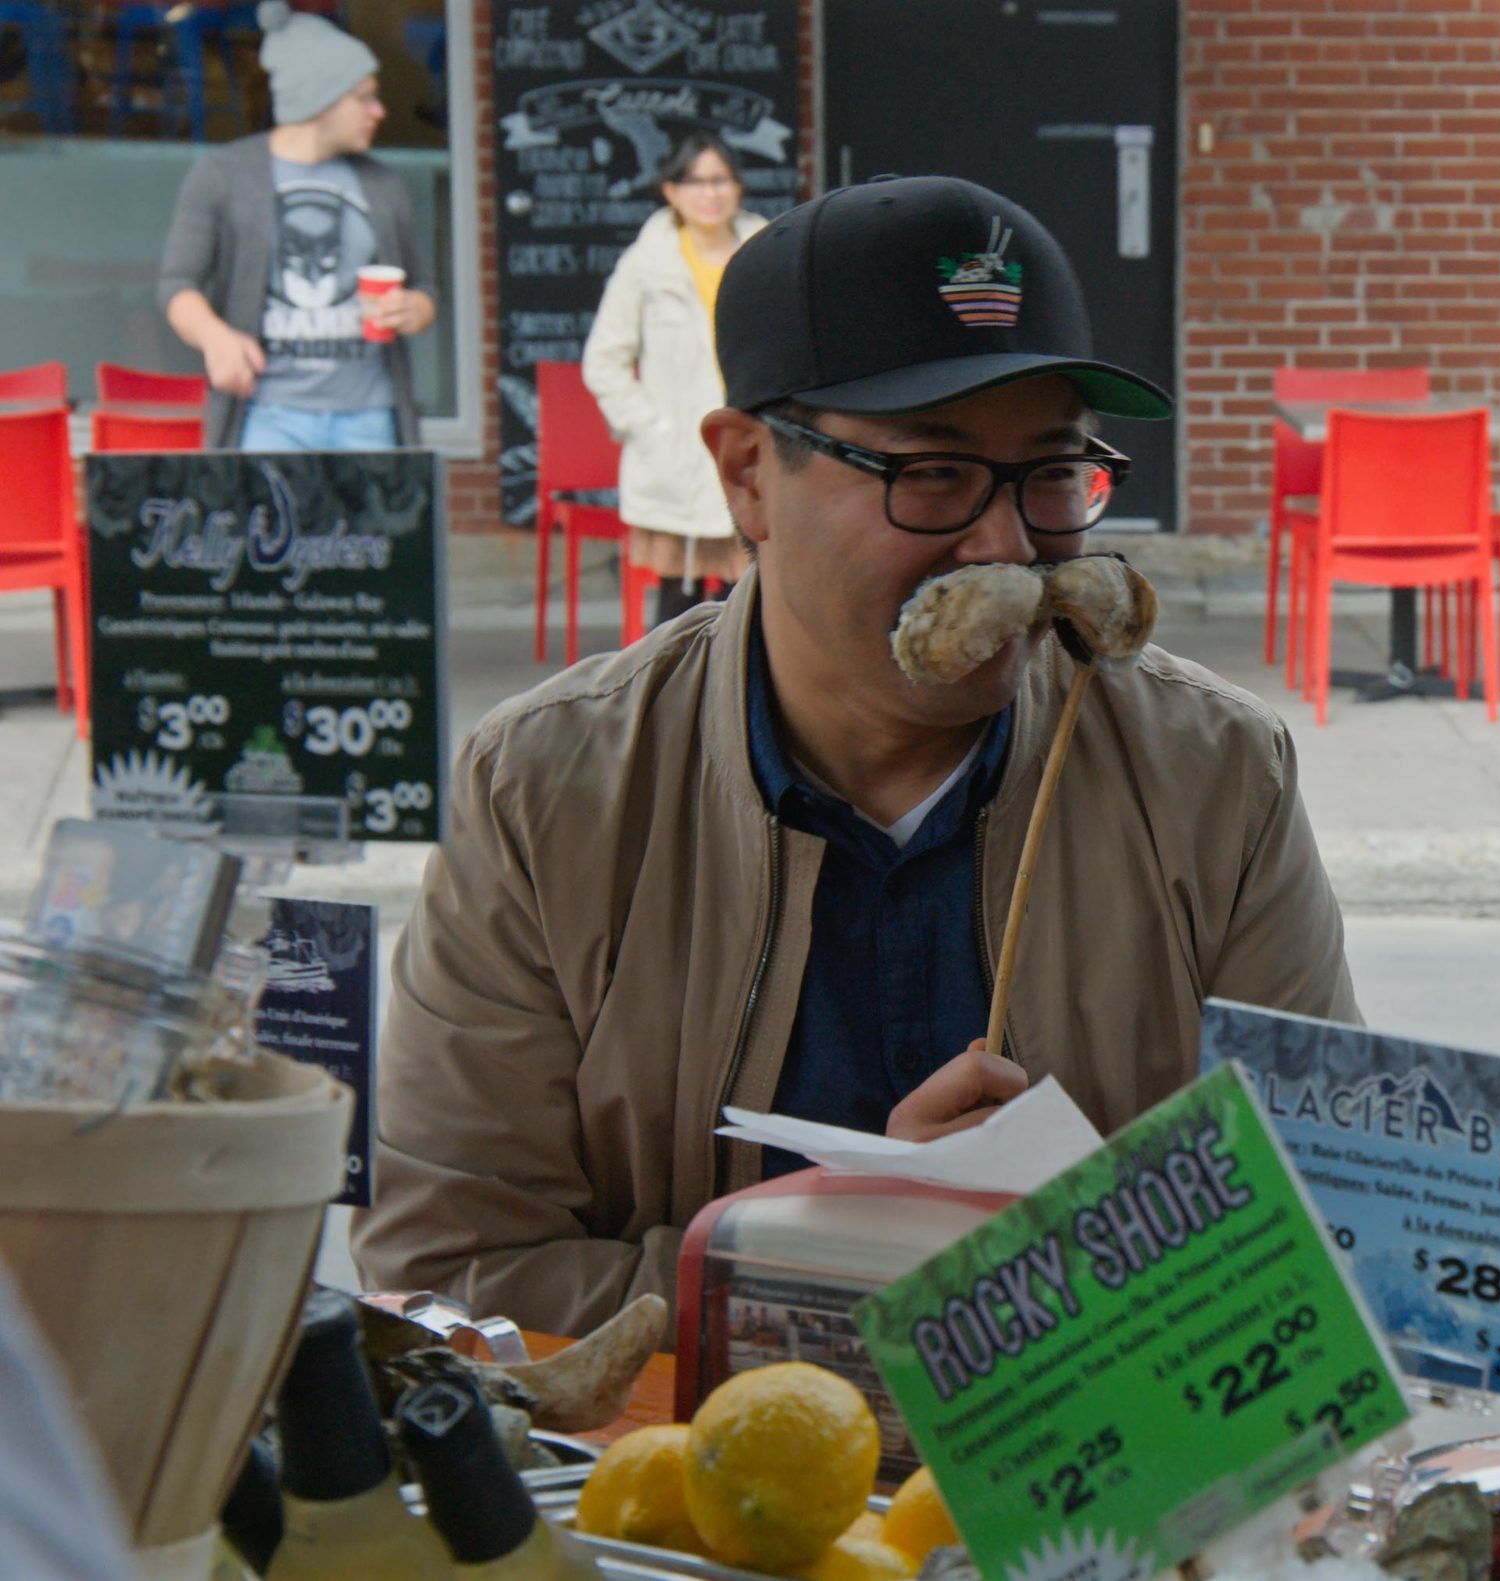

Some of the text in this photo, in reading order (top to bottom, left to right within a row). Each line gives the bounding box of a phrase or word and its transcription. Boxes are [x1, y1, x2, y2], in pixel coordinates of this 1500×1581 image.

[1257, 1072, 1440, 1146] LACIER
[912, 1126, 1253, 1400] ROCKY SHORE
